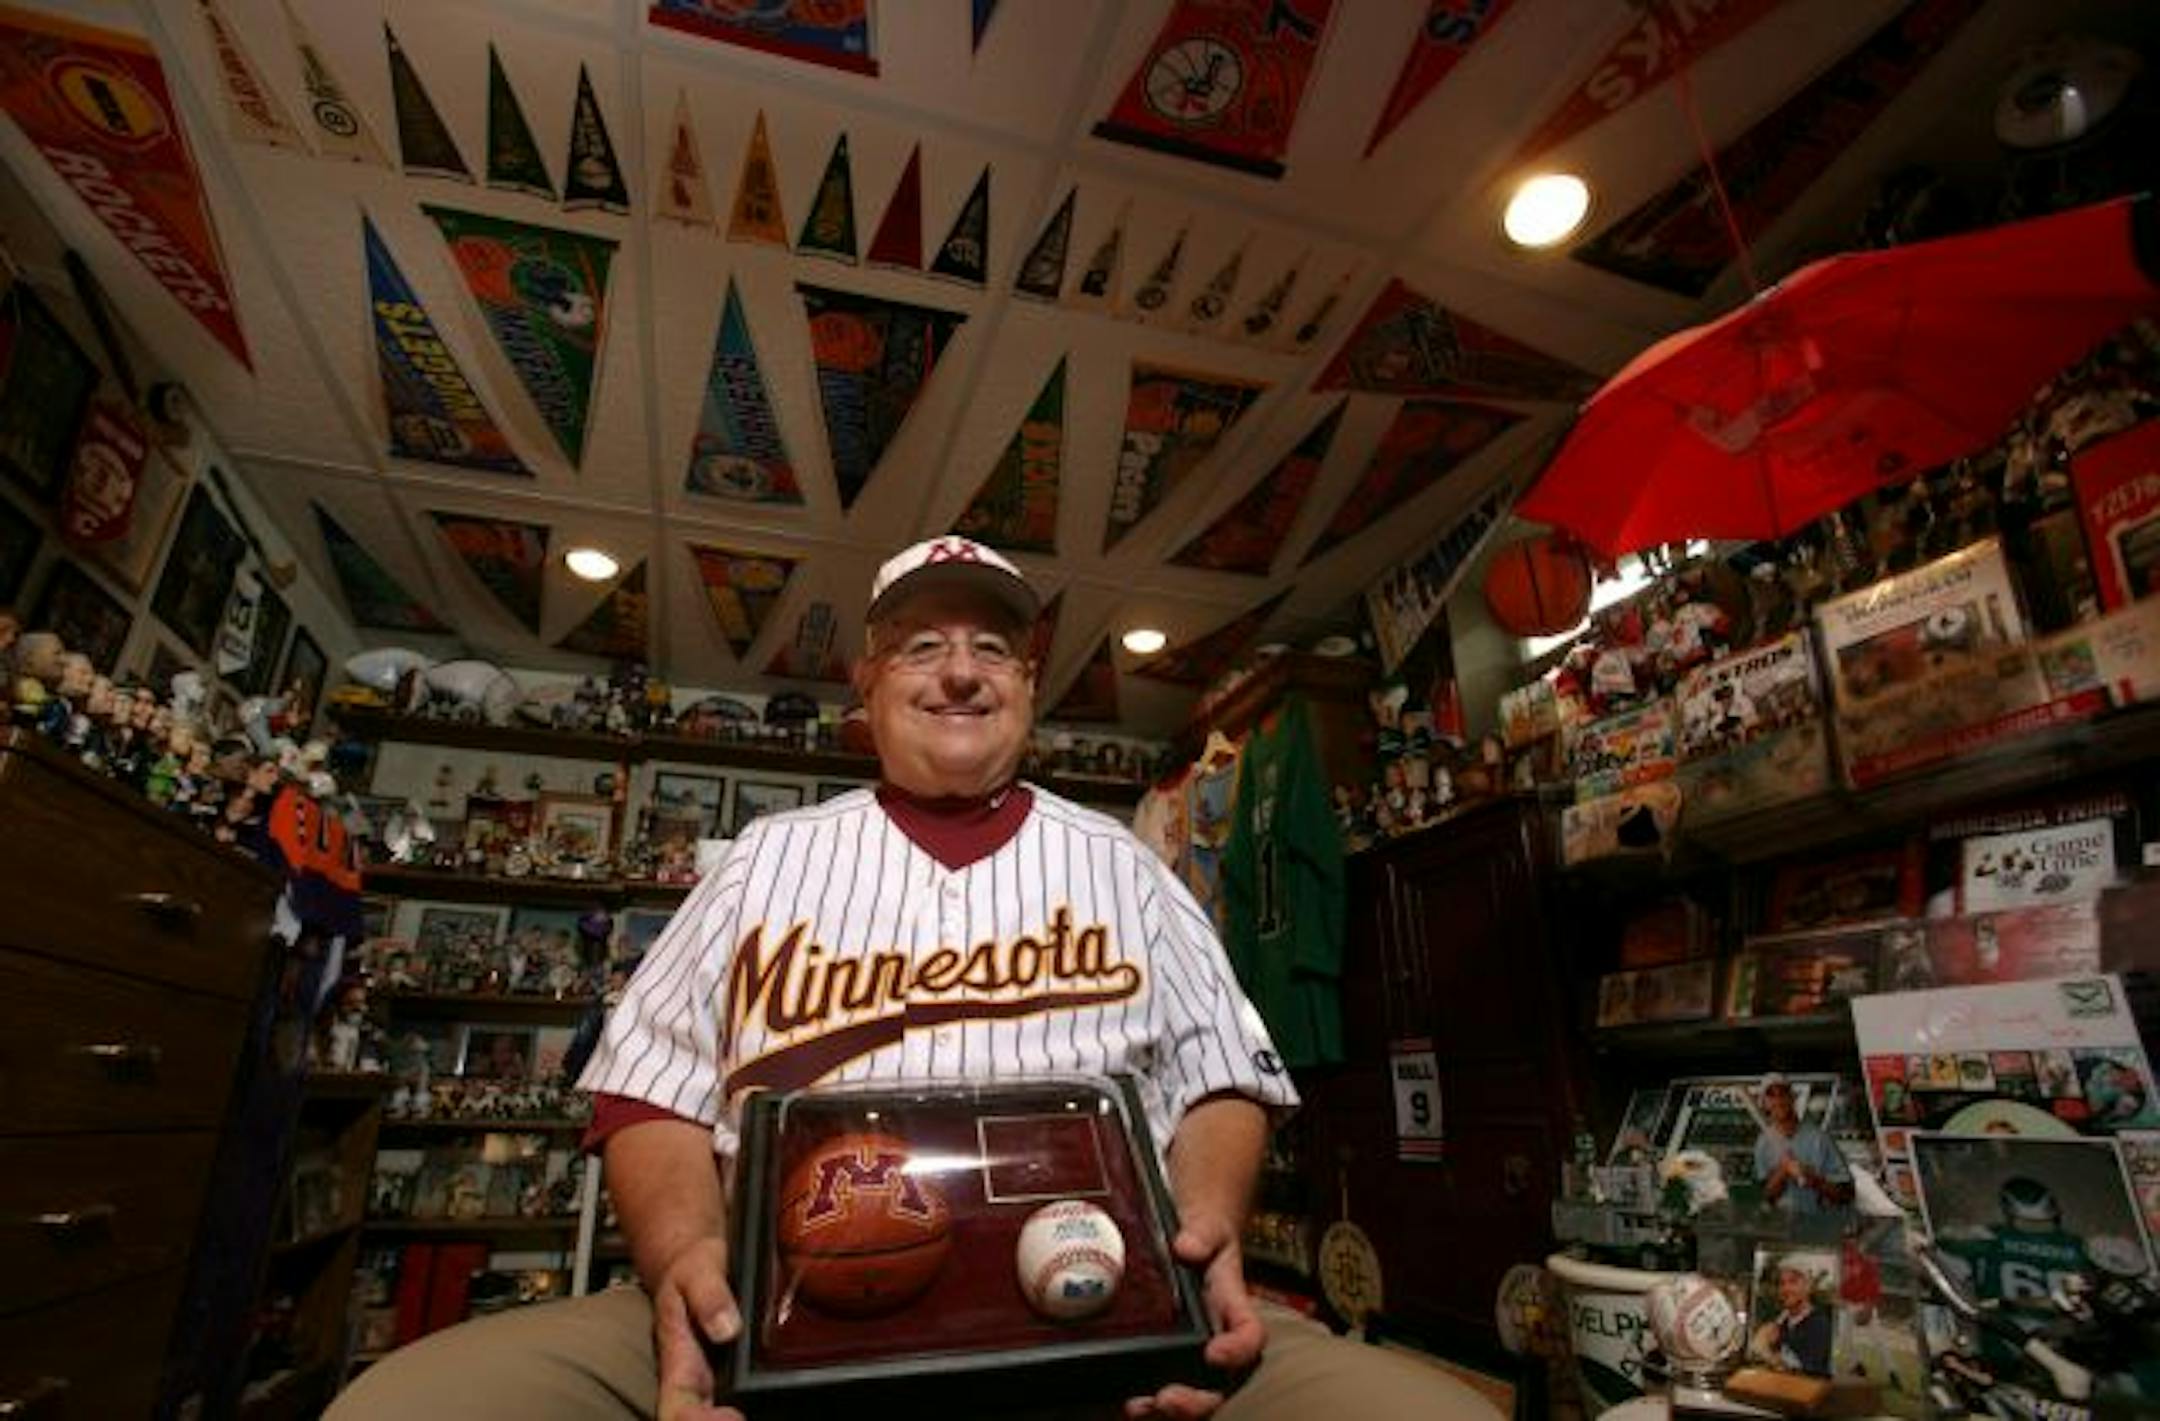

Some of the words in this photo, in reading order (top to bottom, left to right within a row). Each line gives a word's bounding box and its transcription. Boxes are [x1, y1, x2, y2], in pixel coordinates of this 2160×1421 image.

[46, 147, 230, 314] ROCKETS
[2030, 833, 2104, 856] Game
[2039, 853, 2098, 874] Time
[722, 906, 1141, 1040] Minnesota
[1410, 1091, 1430, 1124] 9
[801, 1149, 936, 1234] M
